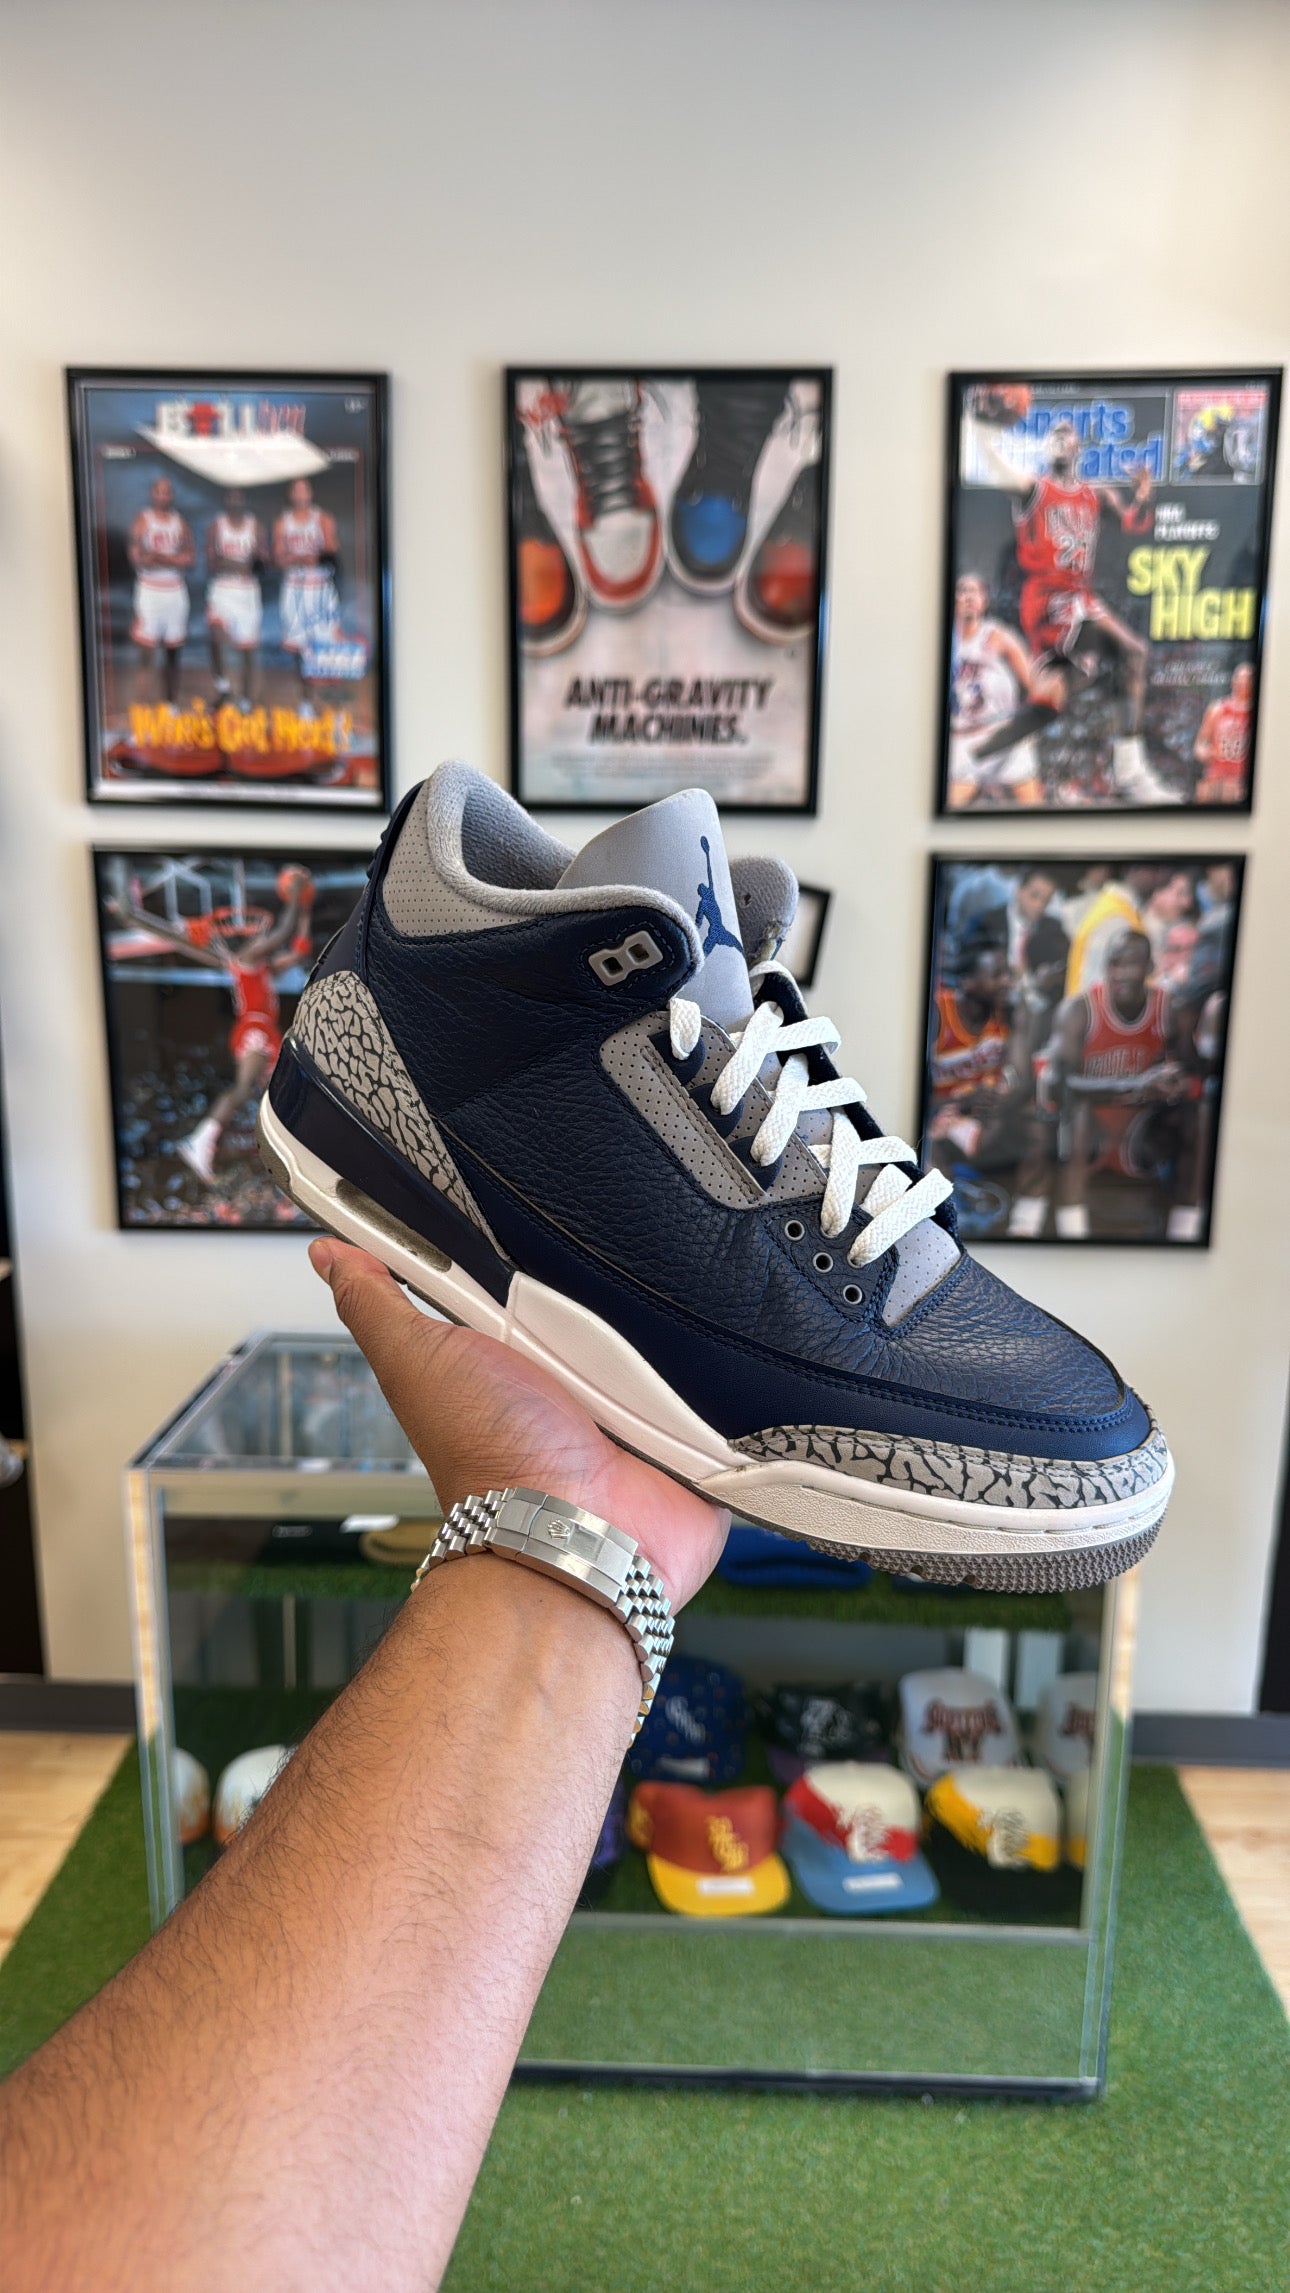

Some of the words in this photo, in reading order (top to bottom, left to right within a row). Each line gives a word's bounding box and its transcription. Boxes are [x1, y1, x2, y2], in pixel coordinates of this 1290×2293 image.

[1127, 546, 1210, 596] SKY
[1150, 587, 1256, 641] HIGH
[564, 674, 775, 709] ANTI-GRAVITY
[587, 712, 748, 745] MACHINES.
